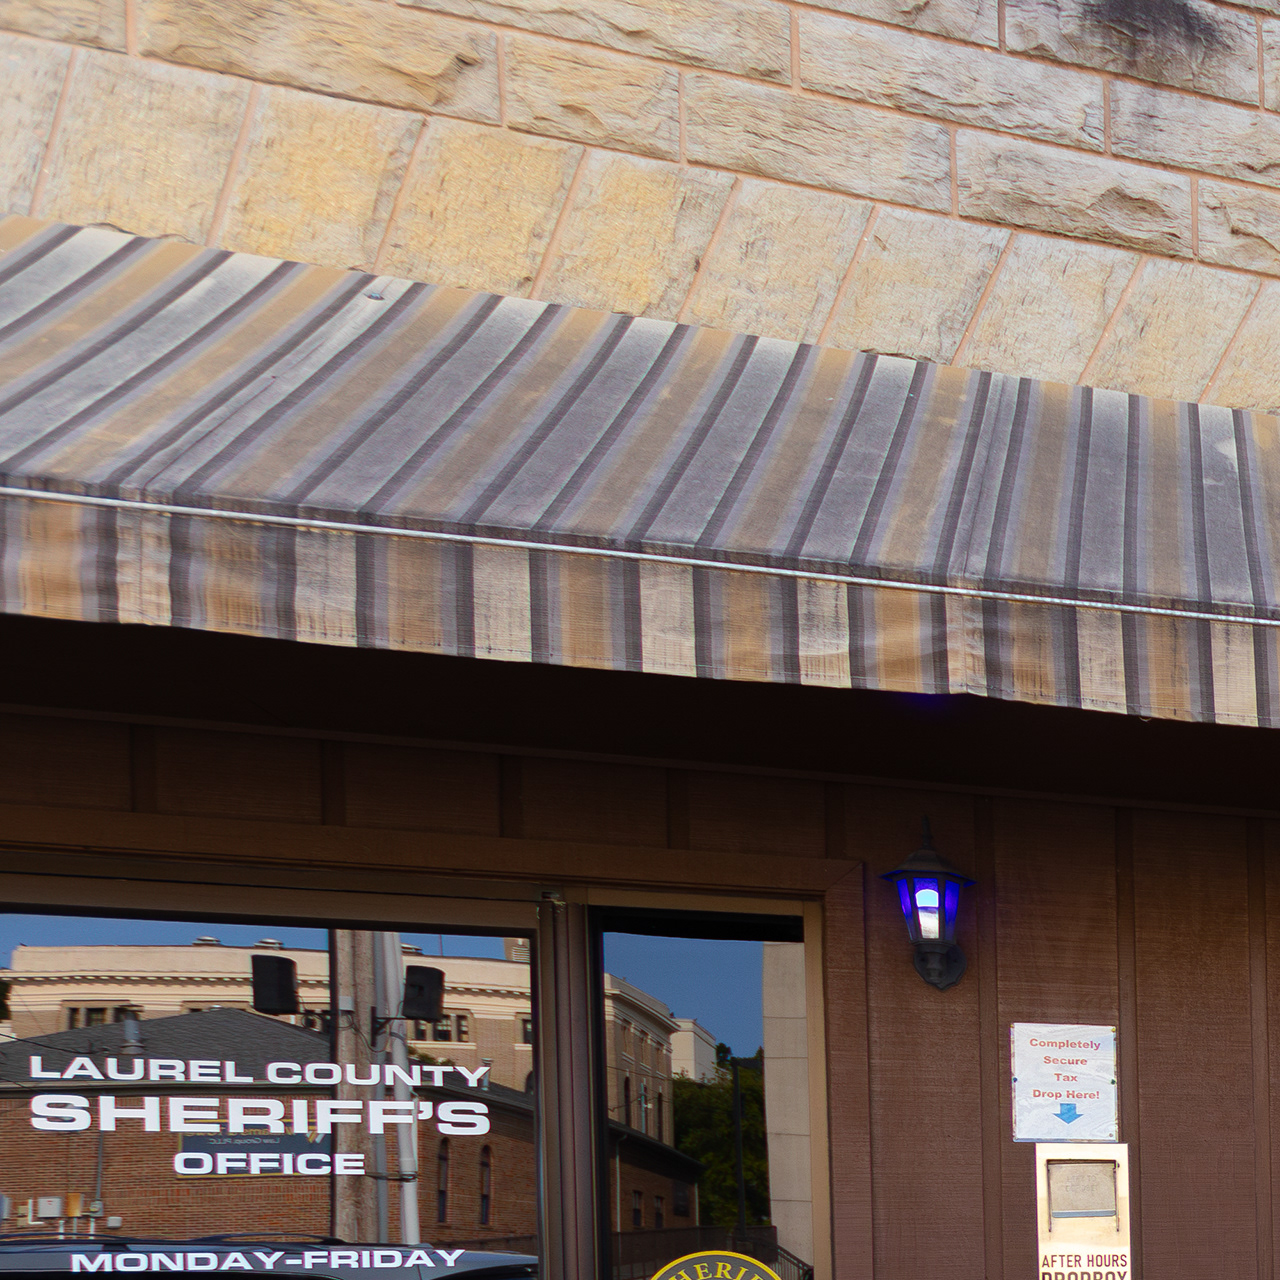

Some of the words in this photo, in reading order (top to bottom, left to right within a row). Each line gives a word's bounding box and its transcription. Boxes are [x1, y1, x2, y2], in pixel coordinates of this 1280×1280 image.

[1029, 1038, 1101, 1050] Completely
[1043, 1056, 1088, 1065] Secure
[30, 1056, 254, 1083] LAUREL
[267, 1062, 492, 1087] COUNTY
[1054, 1073, 1078, 1081] Tax
[1033, 1089, 1062, 1100] Drop
[1066, 1090, 1100, 1099] Here!
[30, 1094, 491, 1136] SHERIFF'S
[174, 1152, 365, 1175] OFFICE
[71, 1249, 465, 1272] MONDAY-FRIDAY
[1042, 1255, 1081, 1267] AFTER
[1087, 1254, 1127, 1267] HOURS
